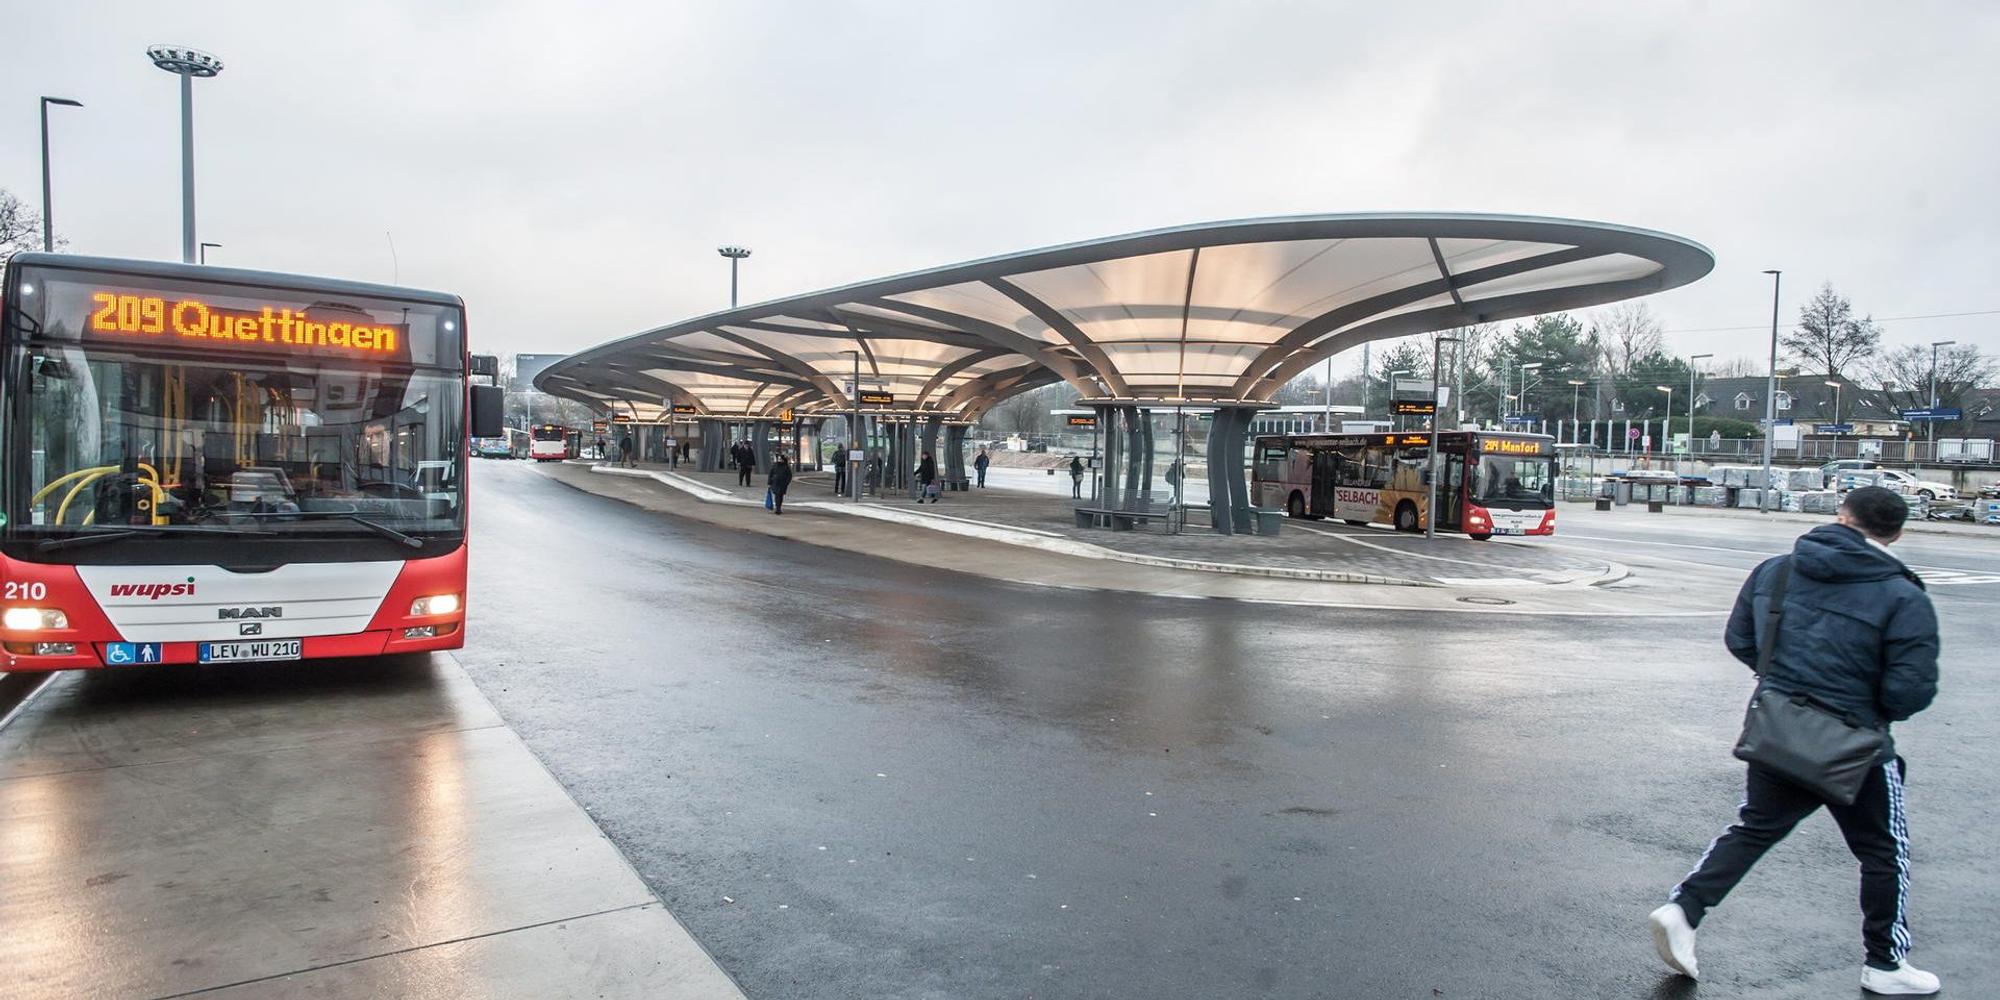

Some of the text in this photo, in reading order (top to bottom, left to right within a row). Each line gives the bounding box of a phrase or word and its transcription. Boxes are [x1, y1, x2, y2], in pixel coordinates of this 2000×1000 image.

[93, 293, 165, 334] 209
[1501, 440, 1540, 454] Manfort
[1338, 489, 1379, 505] SELBACH
[4, 581, 47, 600] 210
[111, 576, 196, 600] wupsi
[218, 606, 283, 620] MAN
[211, 642, 300, 660] LEV WU 210
